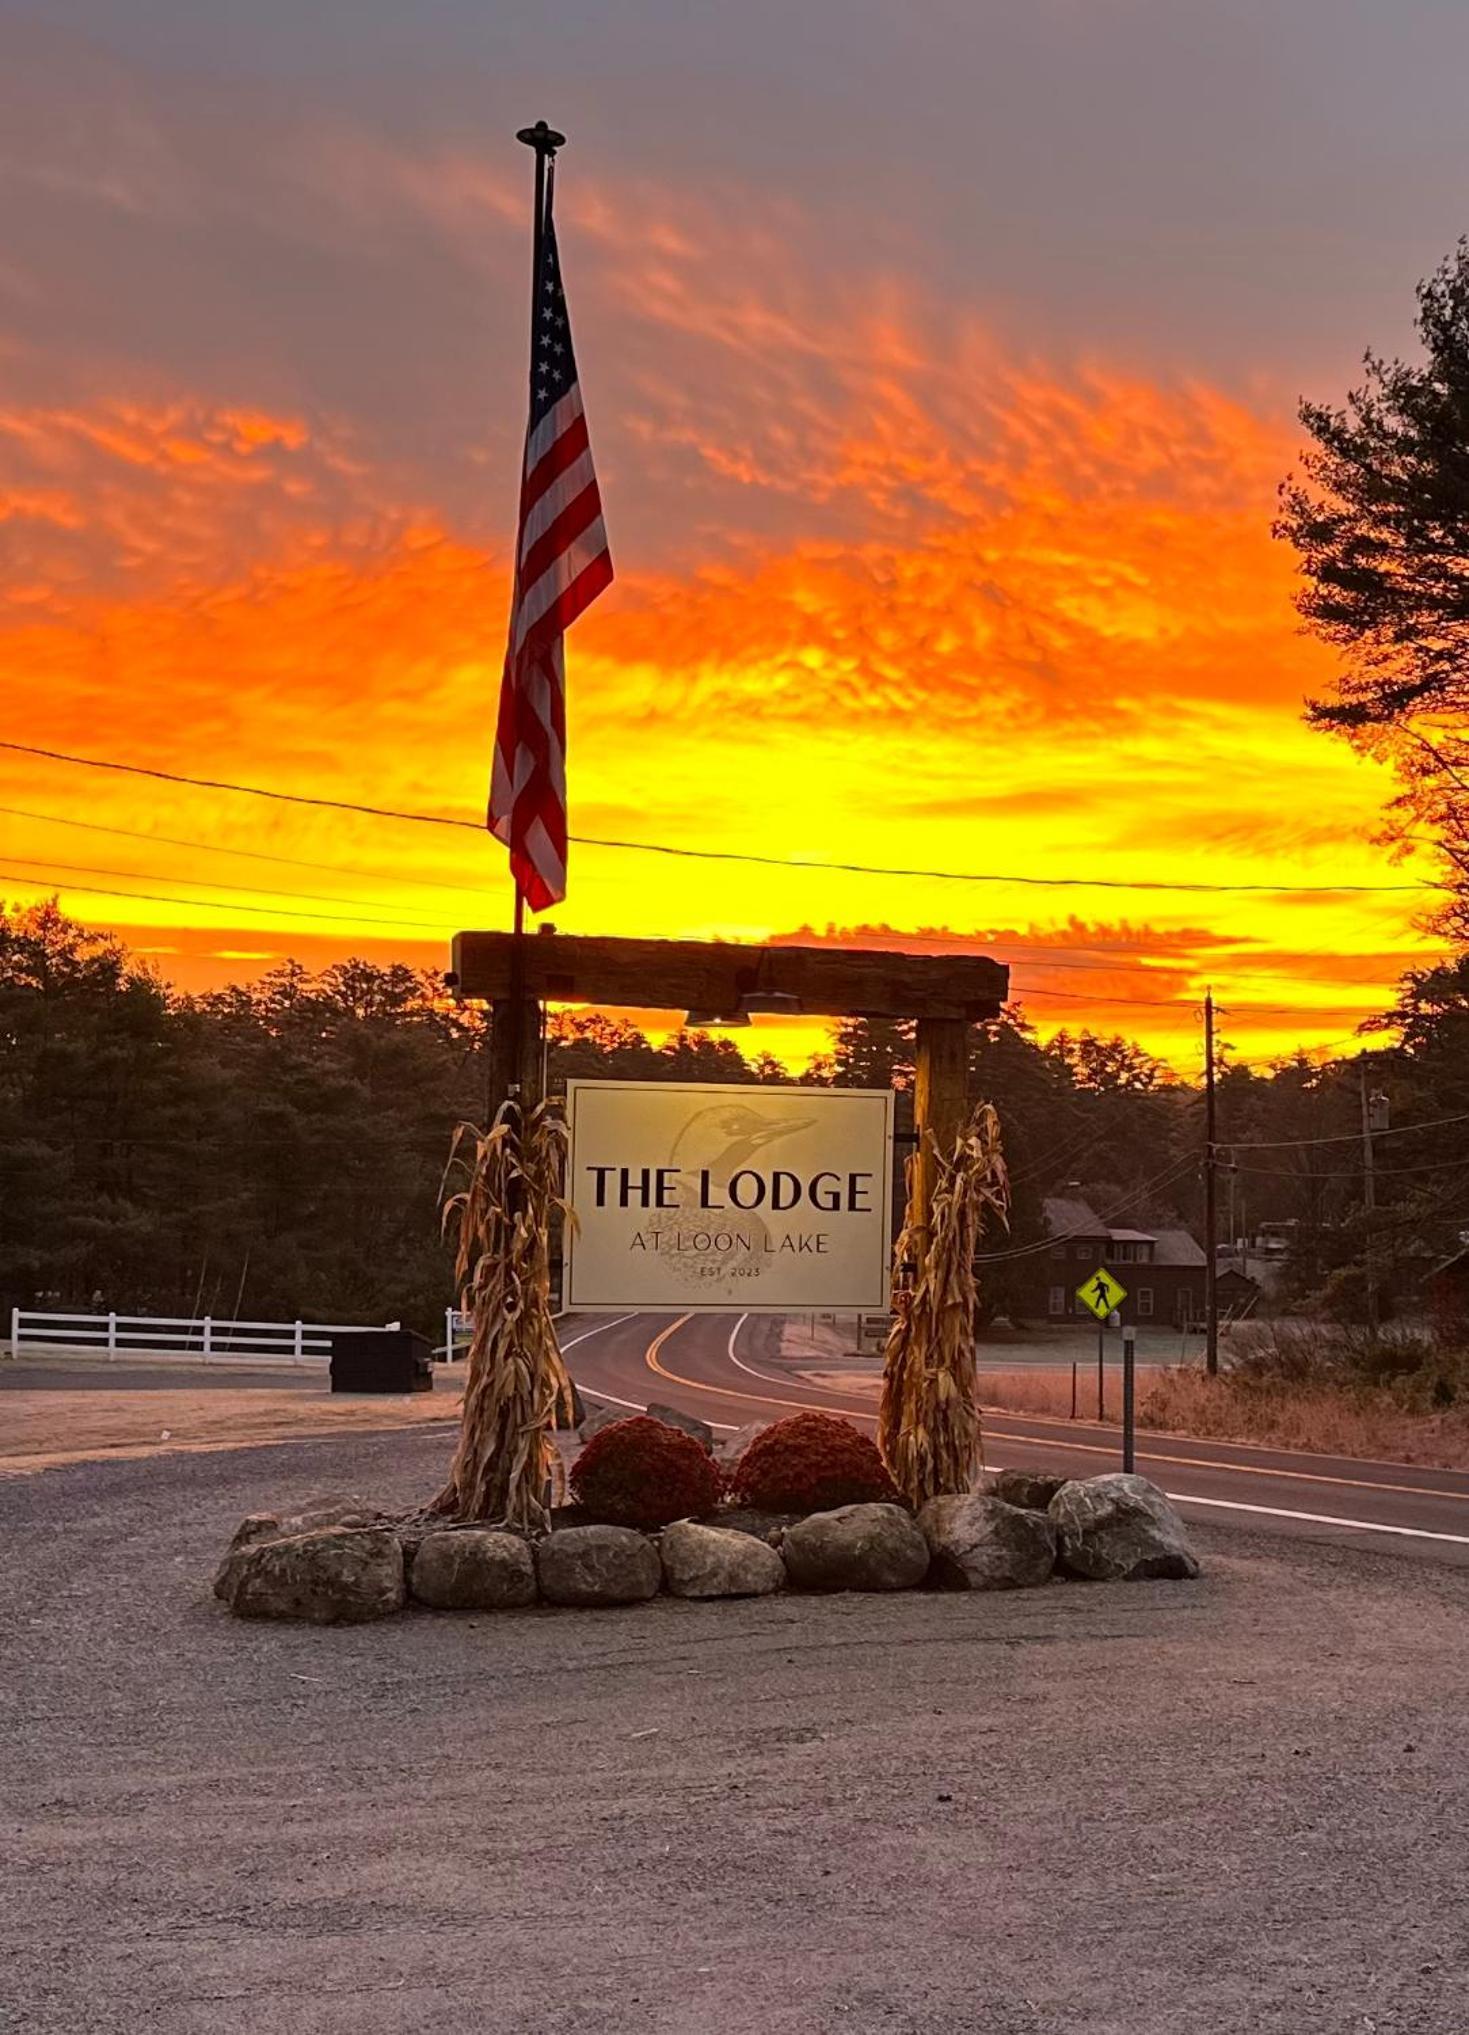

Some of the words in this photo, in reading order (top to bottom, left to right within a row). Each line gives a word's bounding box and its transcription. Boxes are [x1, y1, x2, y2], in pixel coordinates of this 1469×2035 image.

[586, 1166, 681, 1209] THE
[700, 1169, 873, 1212] LODGE
[629, 1231, 664, 1251] AT
[677, 1231, 751, 1252] LOON
[764, 1233, 830, 1253] LAKE
